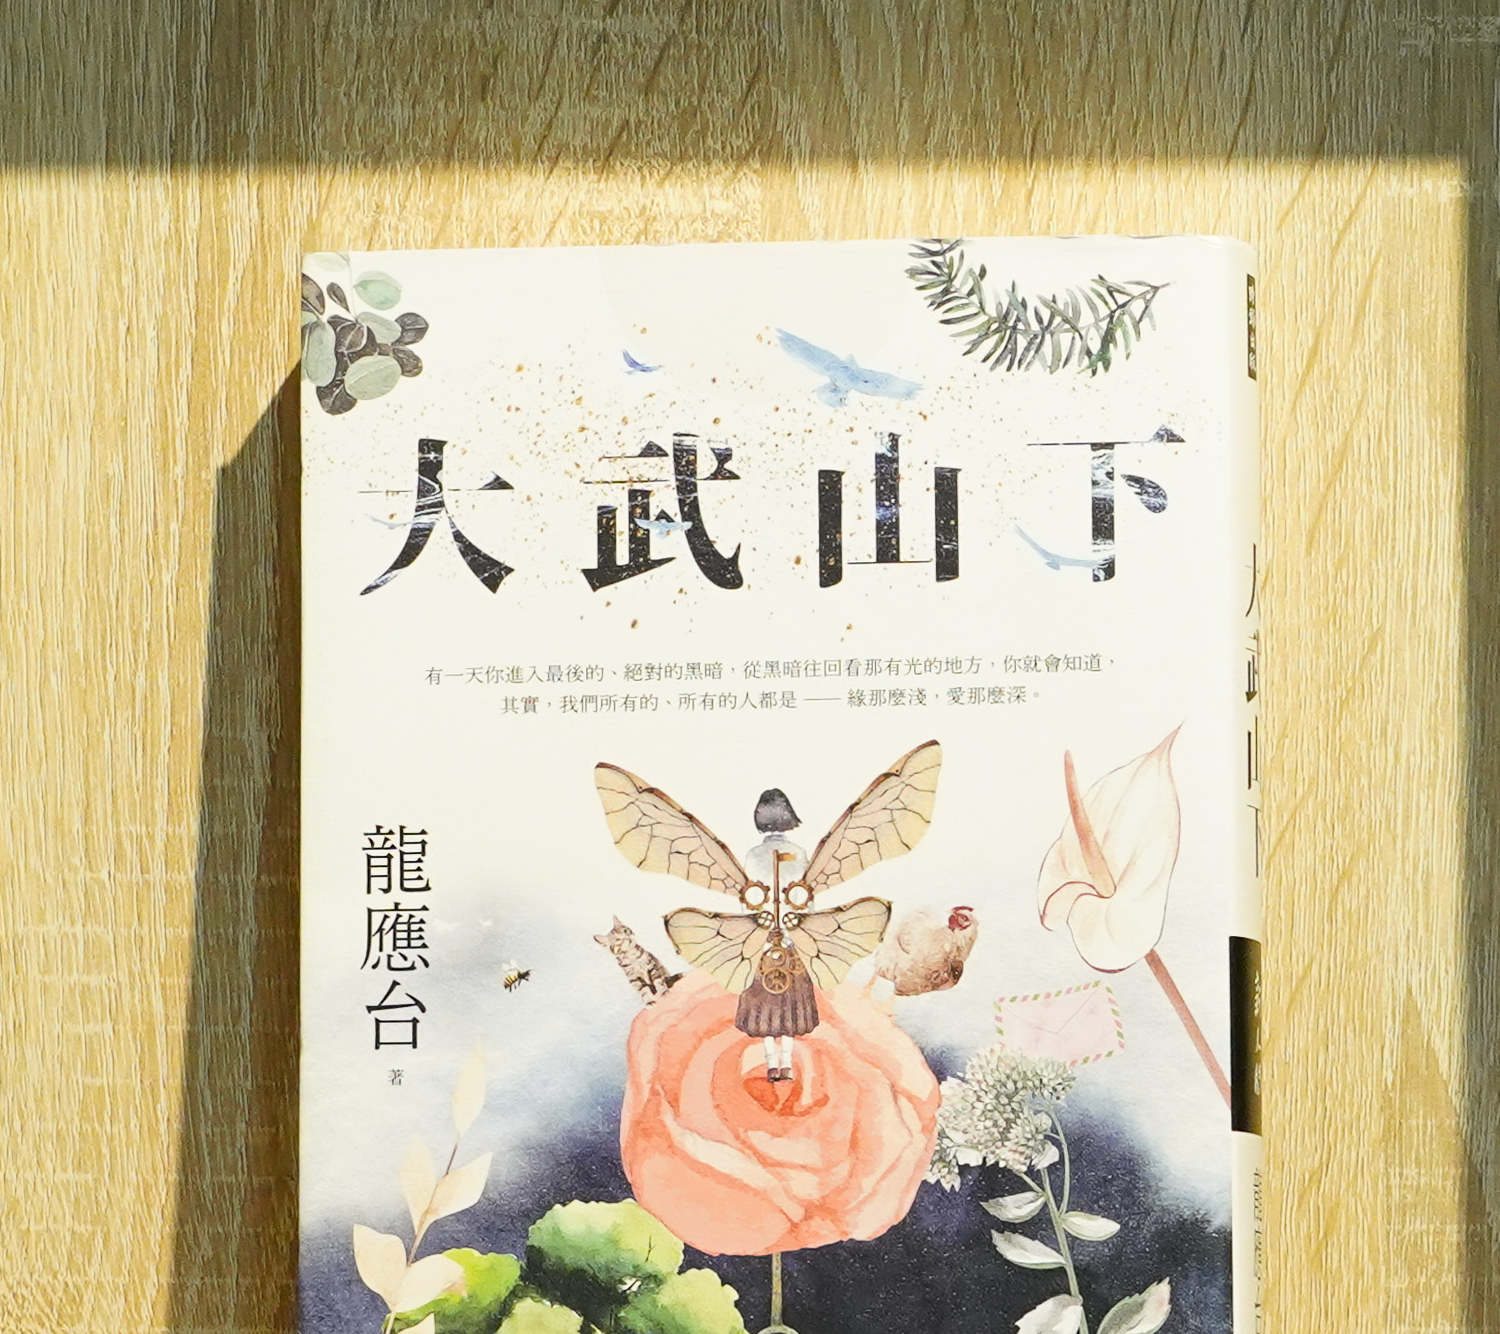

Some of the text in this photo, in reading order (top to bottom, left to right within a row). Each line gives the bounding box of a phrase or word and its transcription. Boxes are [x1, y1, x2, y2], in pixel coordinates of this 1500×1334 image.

[359, 425, 1187, 597] 大武山下
[360, 824, 432, 1086] 龍應台 著
